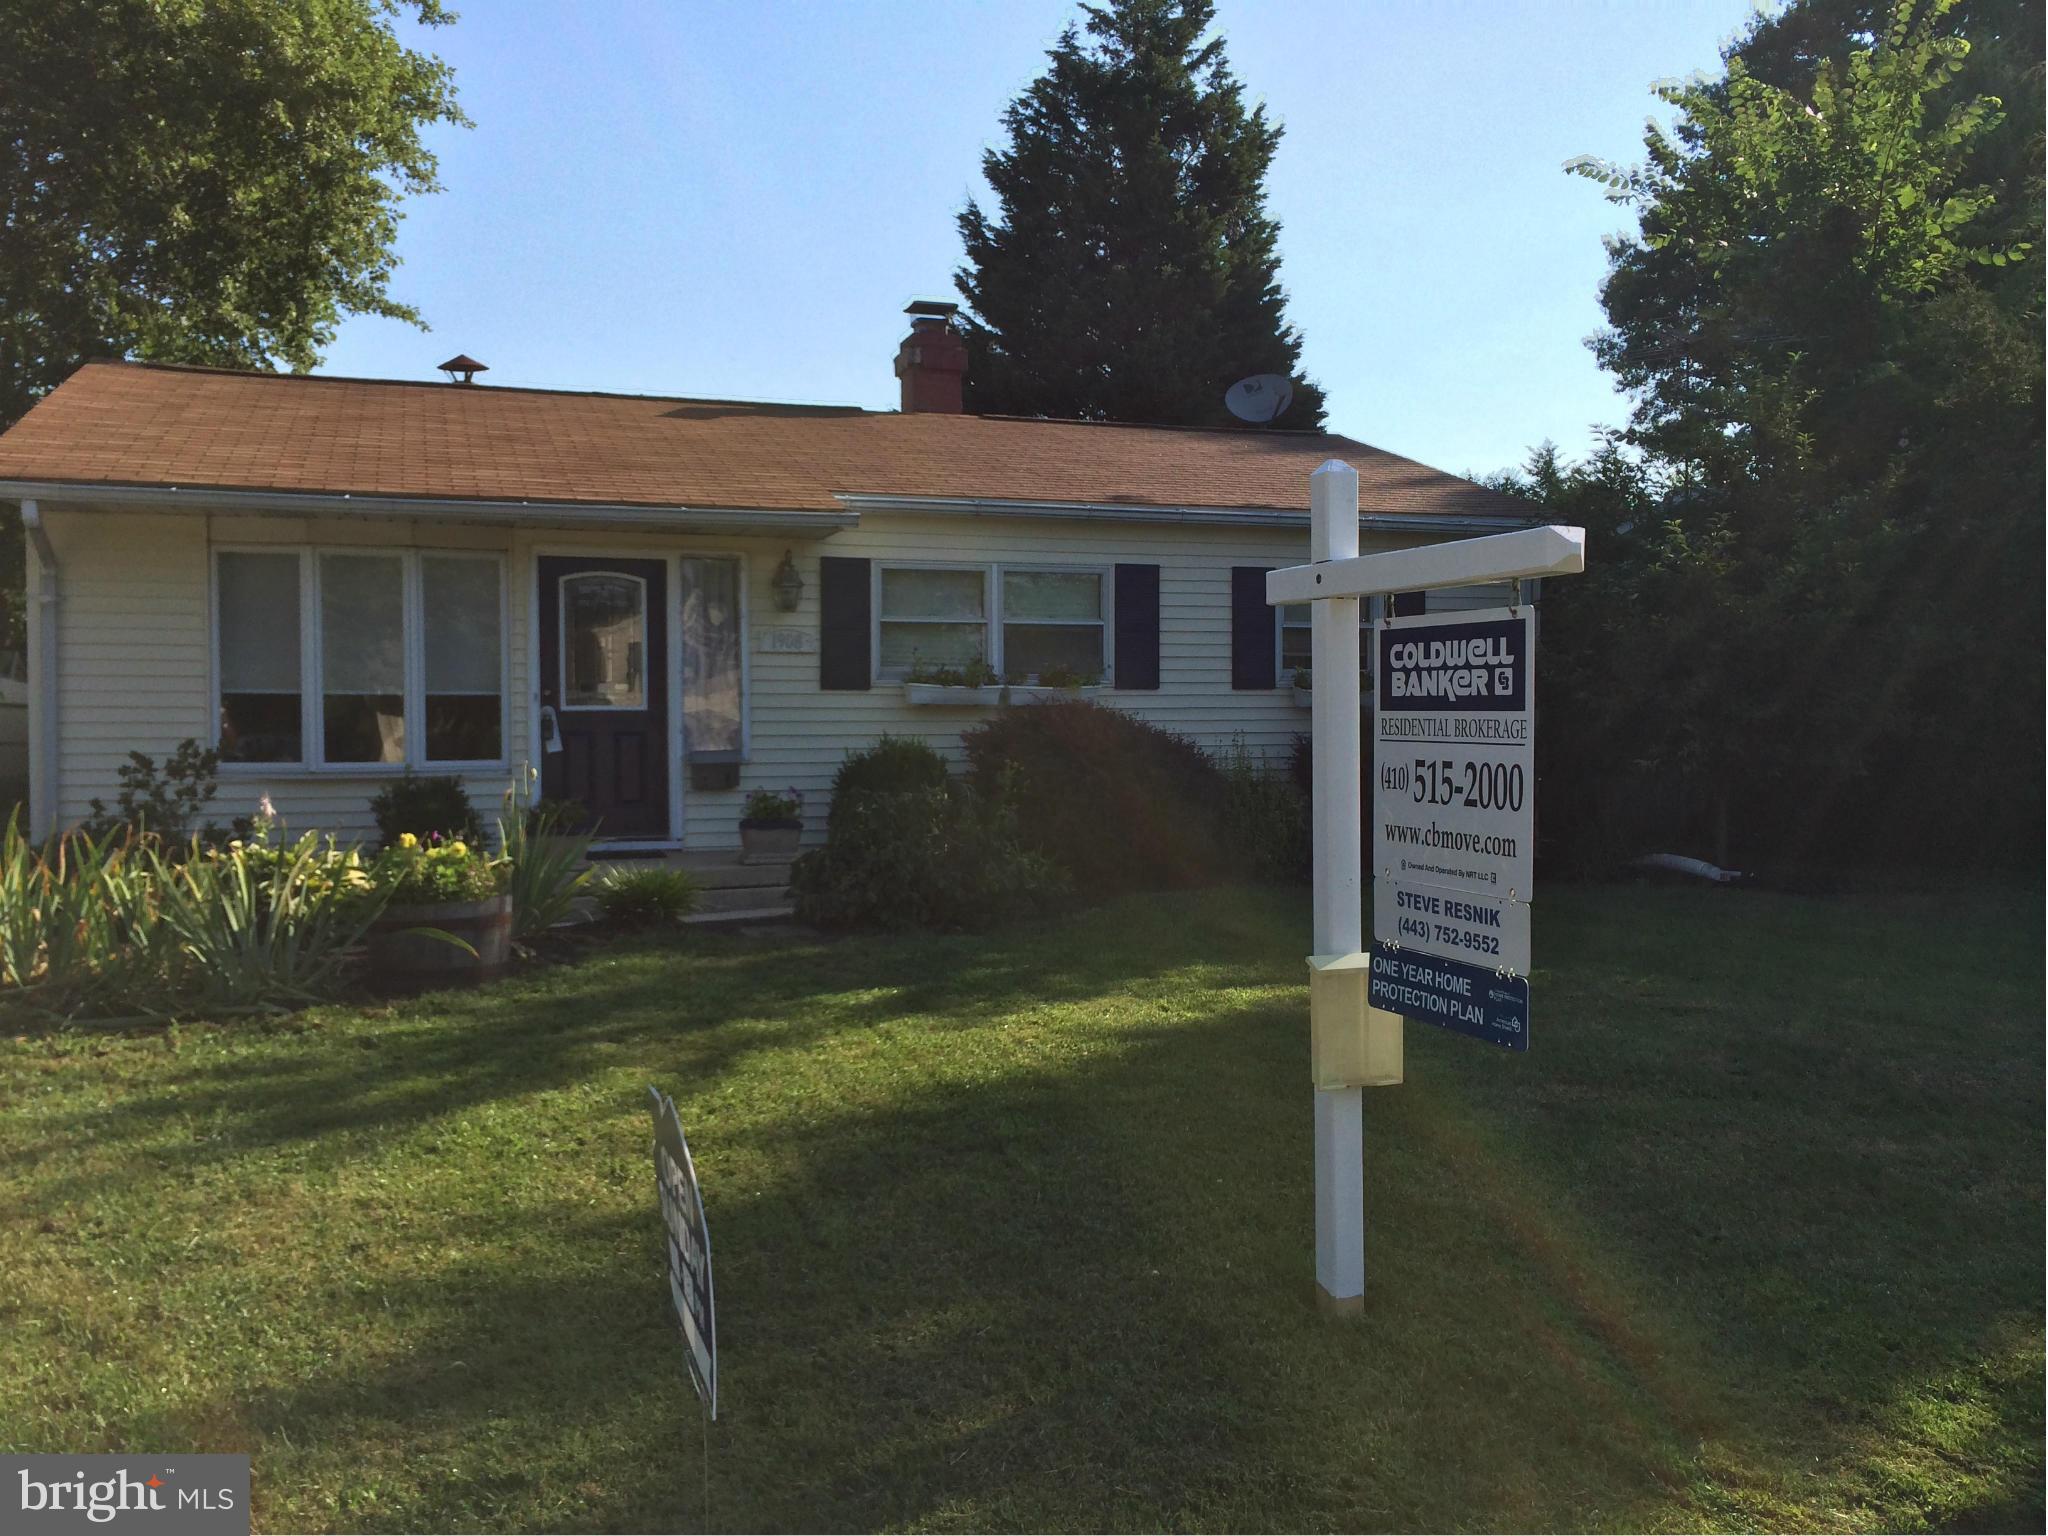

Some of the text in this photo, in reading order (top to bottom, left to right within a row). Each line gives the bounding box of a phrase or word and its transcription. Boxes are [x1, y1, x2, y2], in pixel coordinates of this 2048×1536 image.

[1389, 636, 1515, 669] COLDWELL
[1391, 669, 1489, 702] BANKER
[1381, 717, 1528, 739] RESIDENTIAL BROKERAGE
[1381, 759, 1524, 812] (410) 515-2000
[1384, 821, 1517, 858] www.cbmove.com
[1408, 862, 1489, 880] Owned And Operated By NRT LLC
[1396, 890, 1501, 928] STEVE RESNIK
[1398, 916, 1500, 956] (443) 752-9552
[1373, 956, 1399, 976] ONE
[1401, 962, 1433, 986] YEAR
[1435, 974, 1472, 997] HOME
[1372, 979, 1484, 1025] PROTECTION PLAN
